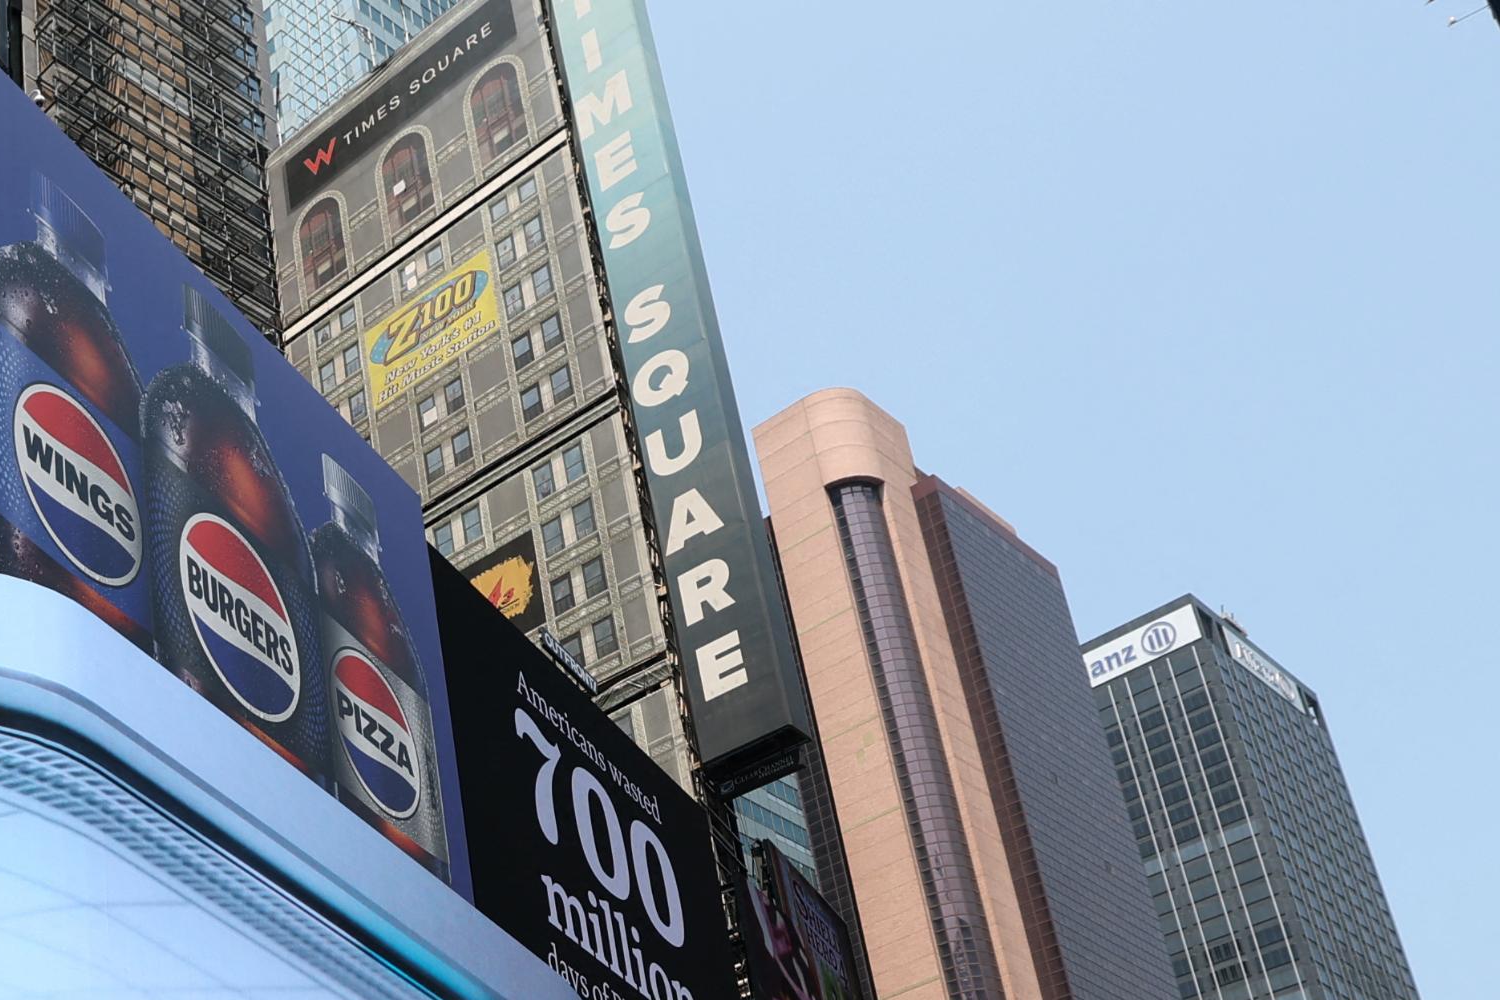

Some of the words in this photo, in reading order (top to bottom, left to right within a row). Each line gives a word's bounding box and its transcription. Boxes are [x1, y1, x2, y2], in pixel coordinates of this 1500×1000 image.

[303, 136, 337, 176] W
[343, 94, 401, 145] TIMES
[409, 22, 493, 95] SQUARE
[378, 383, 399, 406] Hit
[401, 354, 445, 388] Music
[445, 319, 496, 359] Station
[383, 270, 477, 367] Z100
[385, 357, 418, 386] New
[420, 326, 461, 360] York's
[463, 310, 482, 332] #1
[22, 422, 136, 543] WINGS
[624, 284, 748, 702] SQUARE
[185, 559, 295, 677] BURGERS
[336, 689, 416, 778] PIZZA
[516, 670, 607, 774] Americans
[608, 757, 662, 825] wasted
[514, 707, 685, 948] 700
[547, 942, 589, 999] days
